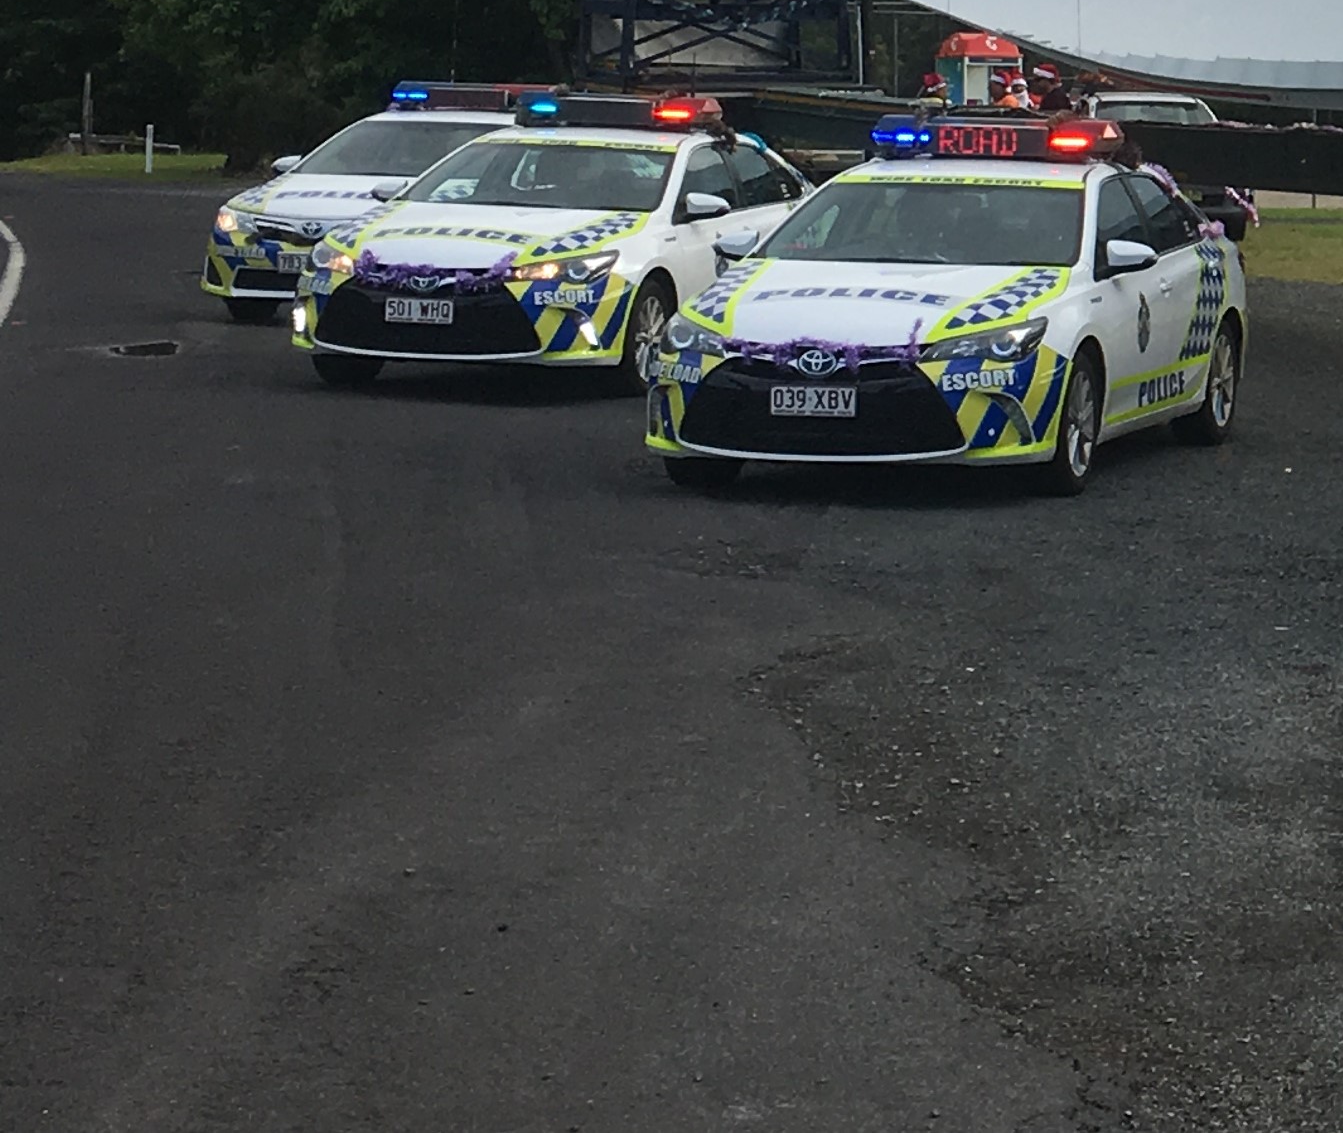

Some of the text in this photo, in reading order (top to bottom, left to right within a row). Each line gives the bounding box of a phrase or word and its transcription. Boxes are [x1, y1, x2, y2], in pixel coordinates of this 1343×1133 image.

[938, 125, 1018, 156] ROAD
[275, 190, 373, 200] POLIC
[373, 227, 532, 244] POLICE
[534, 289, 595, 306] ESCORT
[753, 288, 951, 306] POLICE
[388, 300, 450, 318] 501 WHQ
[667, 363, 701, 384] LOAD
[941, 368, 1016, 392] ESCORT
[774, 388, 853, 409] 039 XBV
[1137, 371, 1186, 407] POLICE
